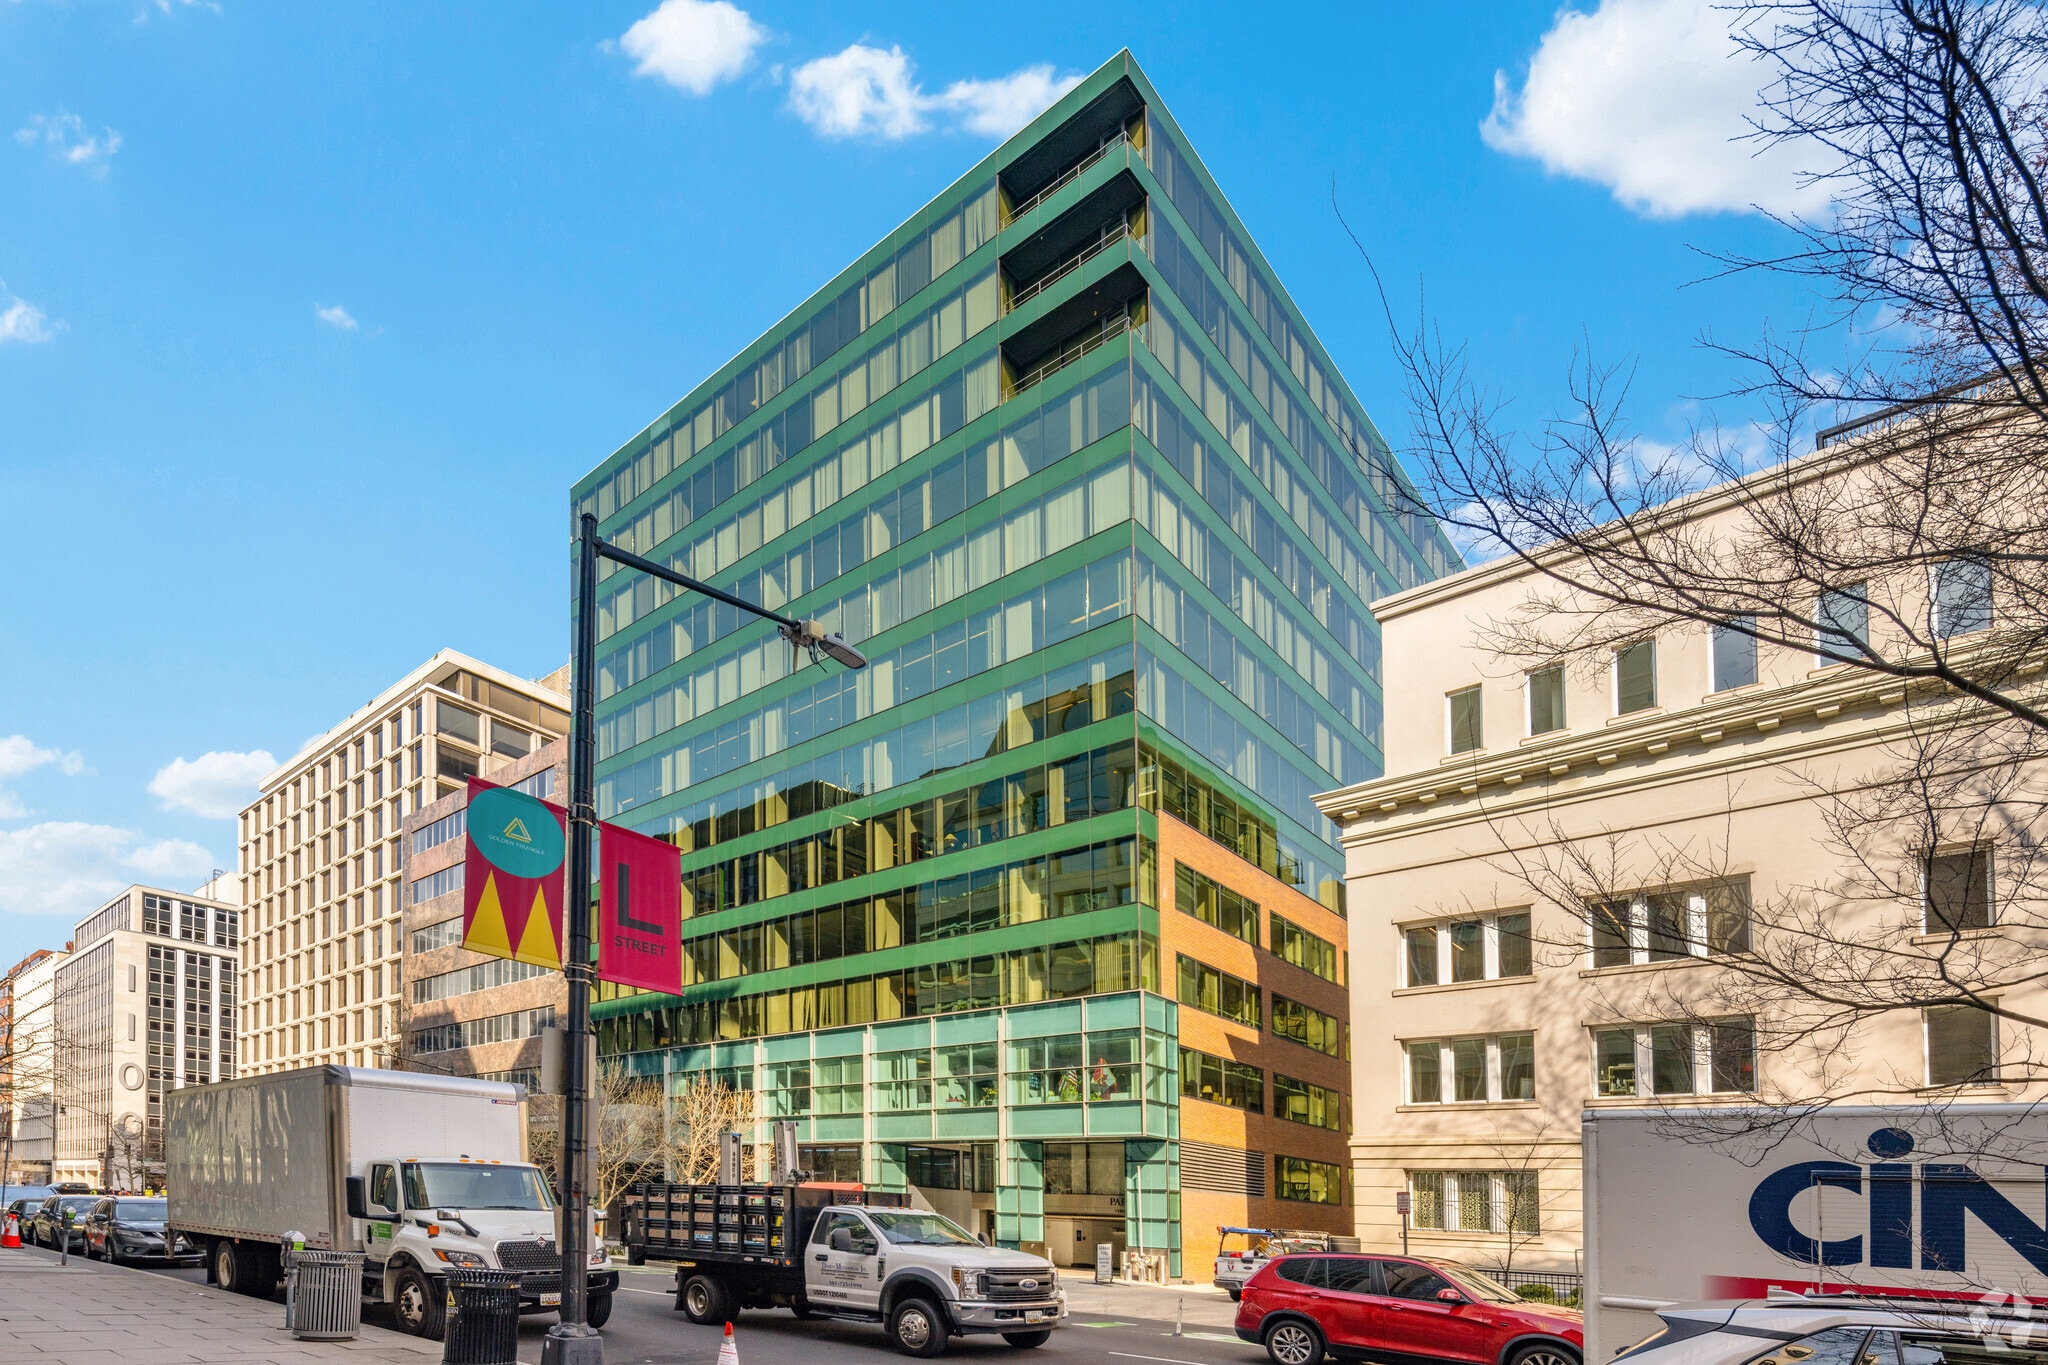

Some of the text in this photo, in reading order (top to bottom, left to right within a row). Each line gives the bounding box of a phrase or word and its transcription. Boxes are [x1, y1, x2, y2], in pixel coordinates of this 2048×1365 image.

[488, 834, 545, 856] GOLDEN TRIANGLE
[617, 862, 664, 936] L
[614, 935, 667, 957] STREET
